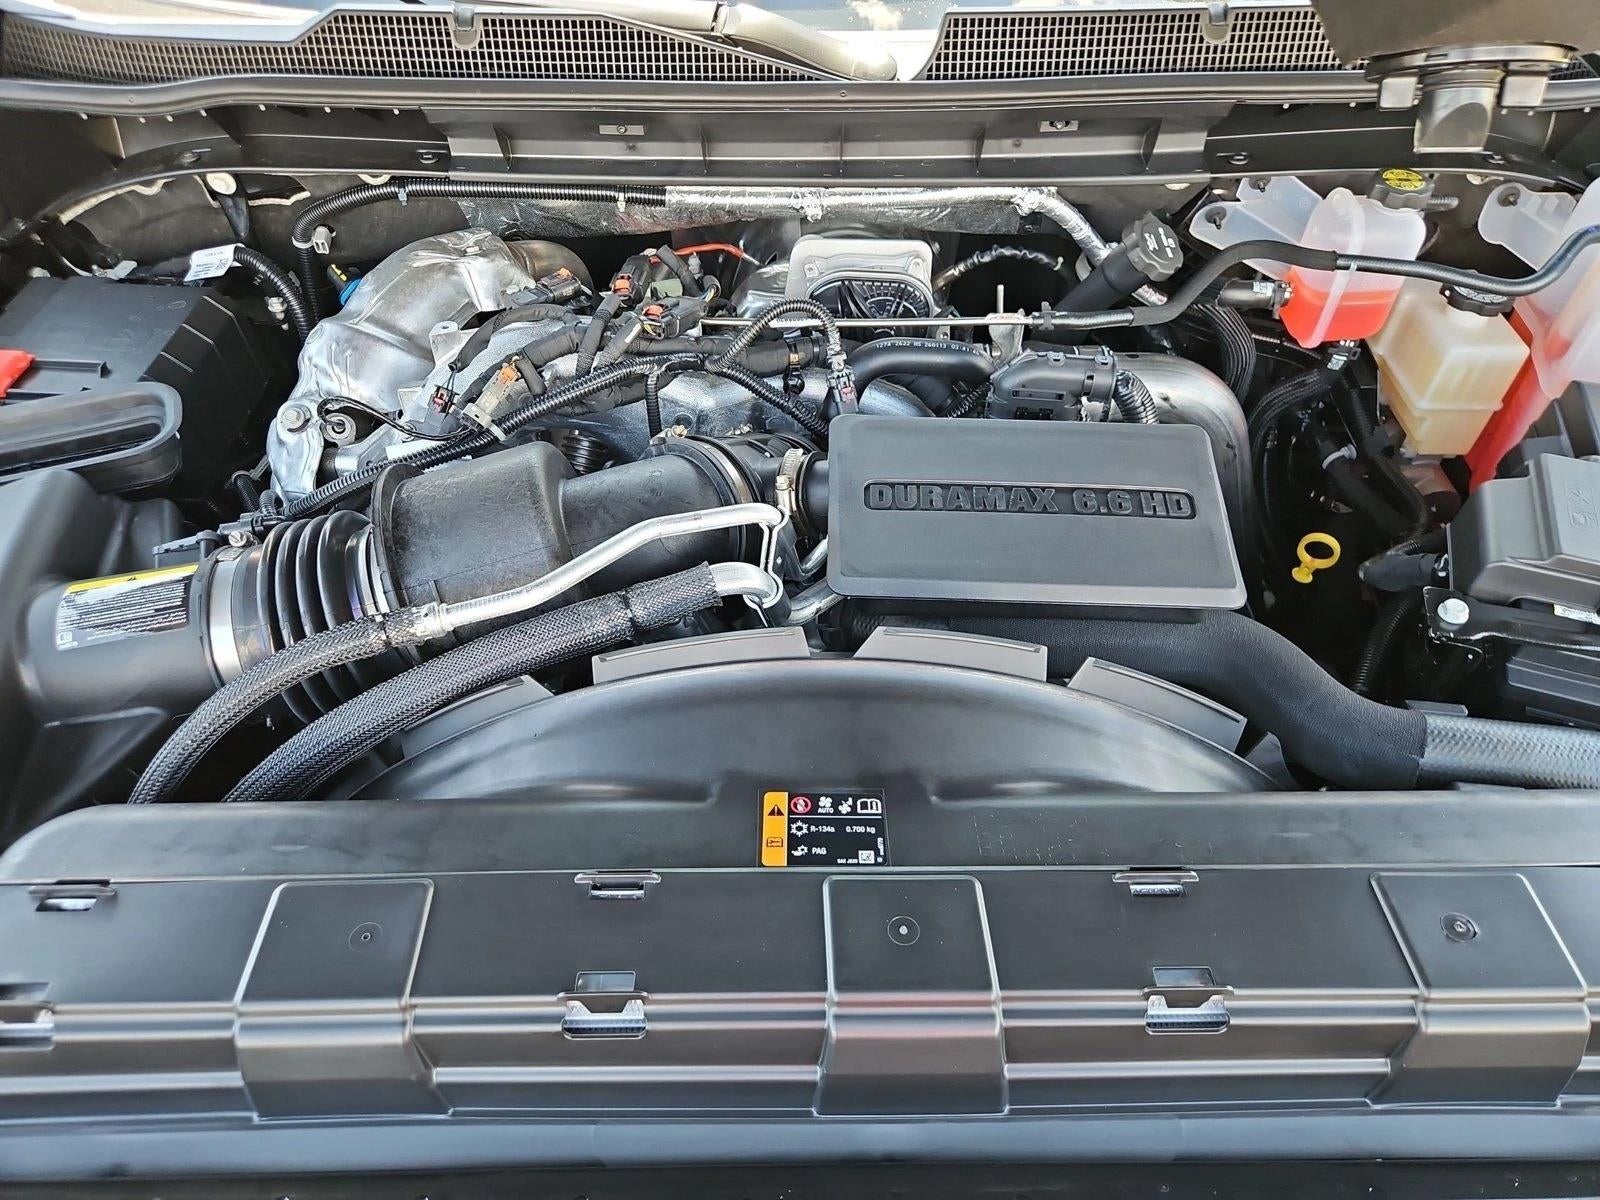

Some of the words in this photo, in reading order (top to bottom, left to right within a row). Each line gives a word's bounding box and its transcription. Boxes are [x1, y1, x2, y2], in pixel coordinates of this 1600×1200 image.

[869, 484, 1058, 512] DURAMAX
[1072, 489, 1132, 515] 6.6
[1140, 492, 1191, 517] HD
[810, 825, 835, 833] R-134a
[866, 825, 876, 834] kg
[811, 847, 827, 855] PAG
